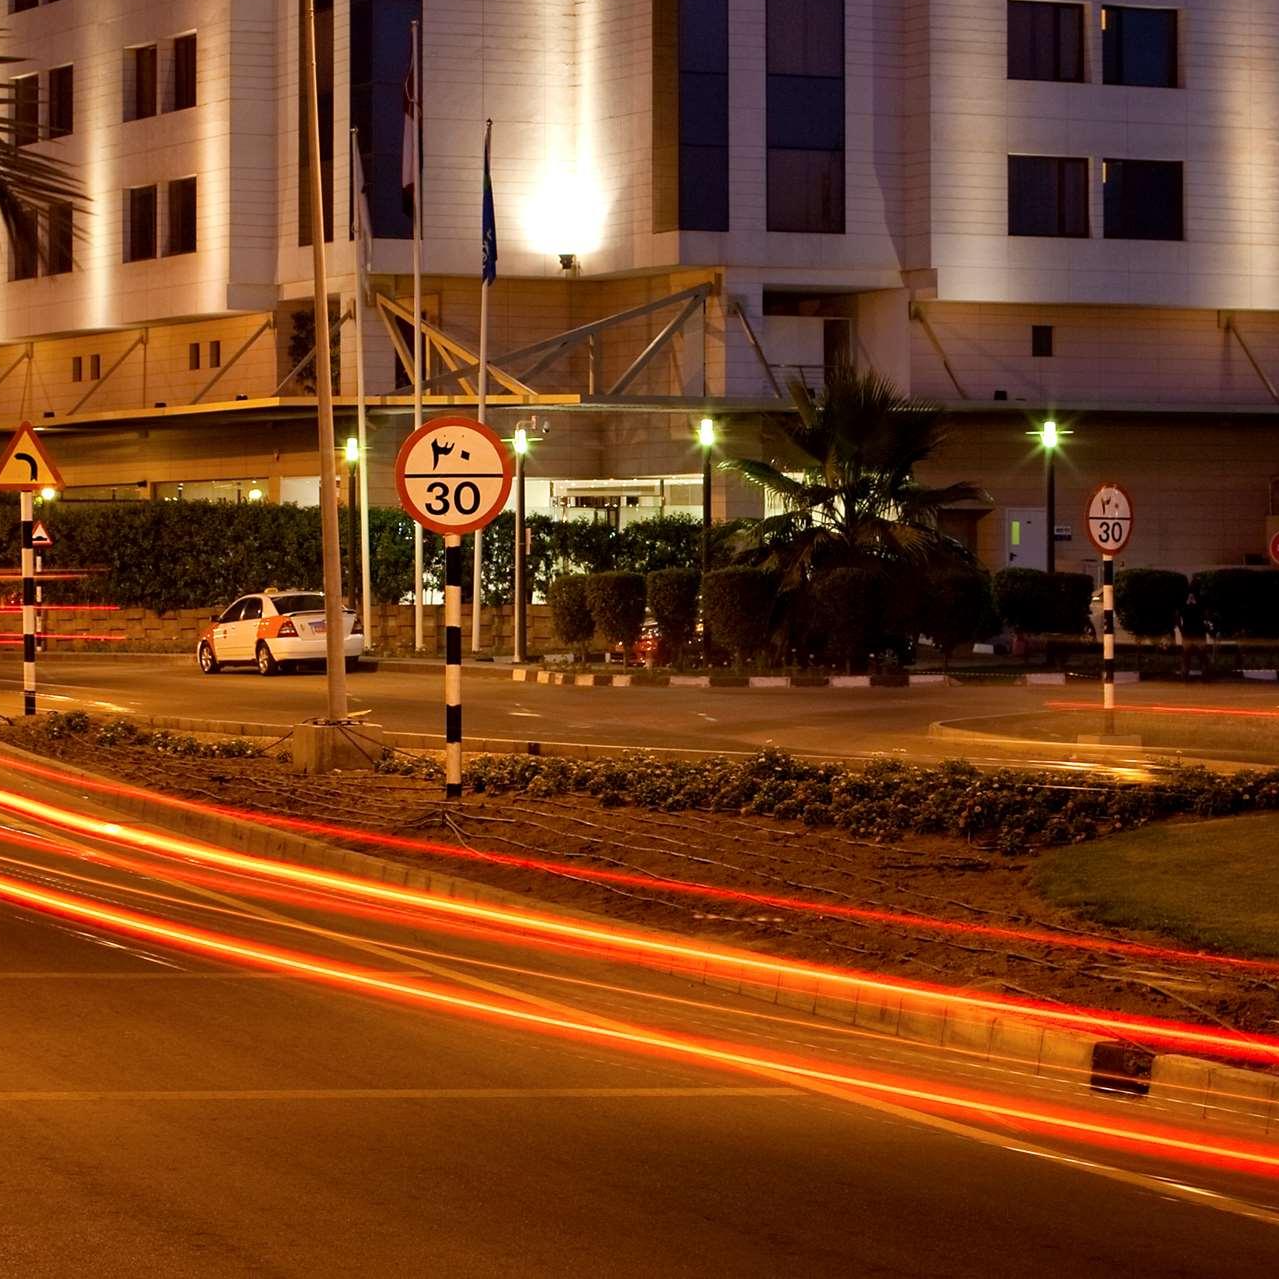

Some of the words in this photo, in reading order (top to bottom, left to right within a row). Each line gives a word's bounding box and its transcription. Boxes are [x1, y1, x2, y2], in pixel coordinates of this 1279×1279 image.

[431, 438, 471, 471] ٣٠
[425, 481, 481, 516] 30
[1098, 521, 1123, 543] 30
